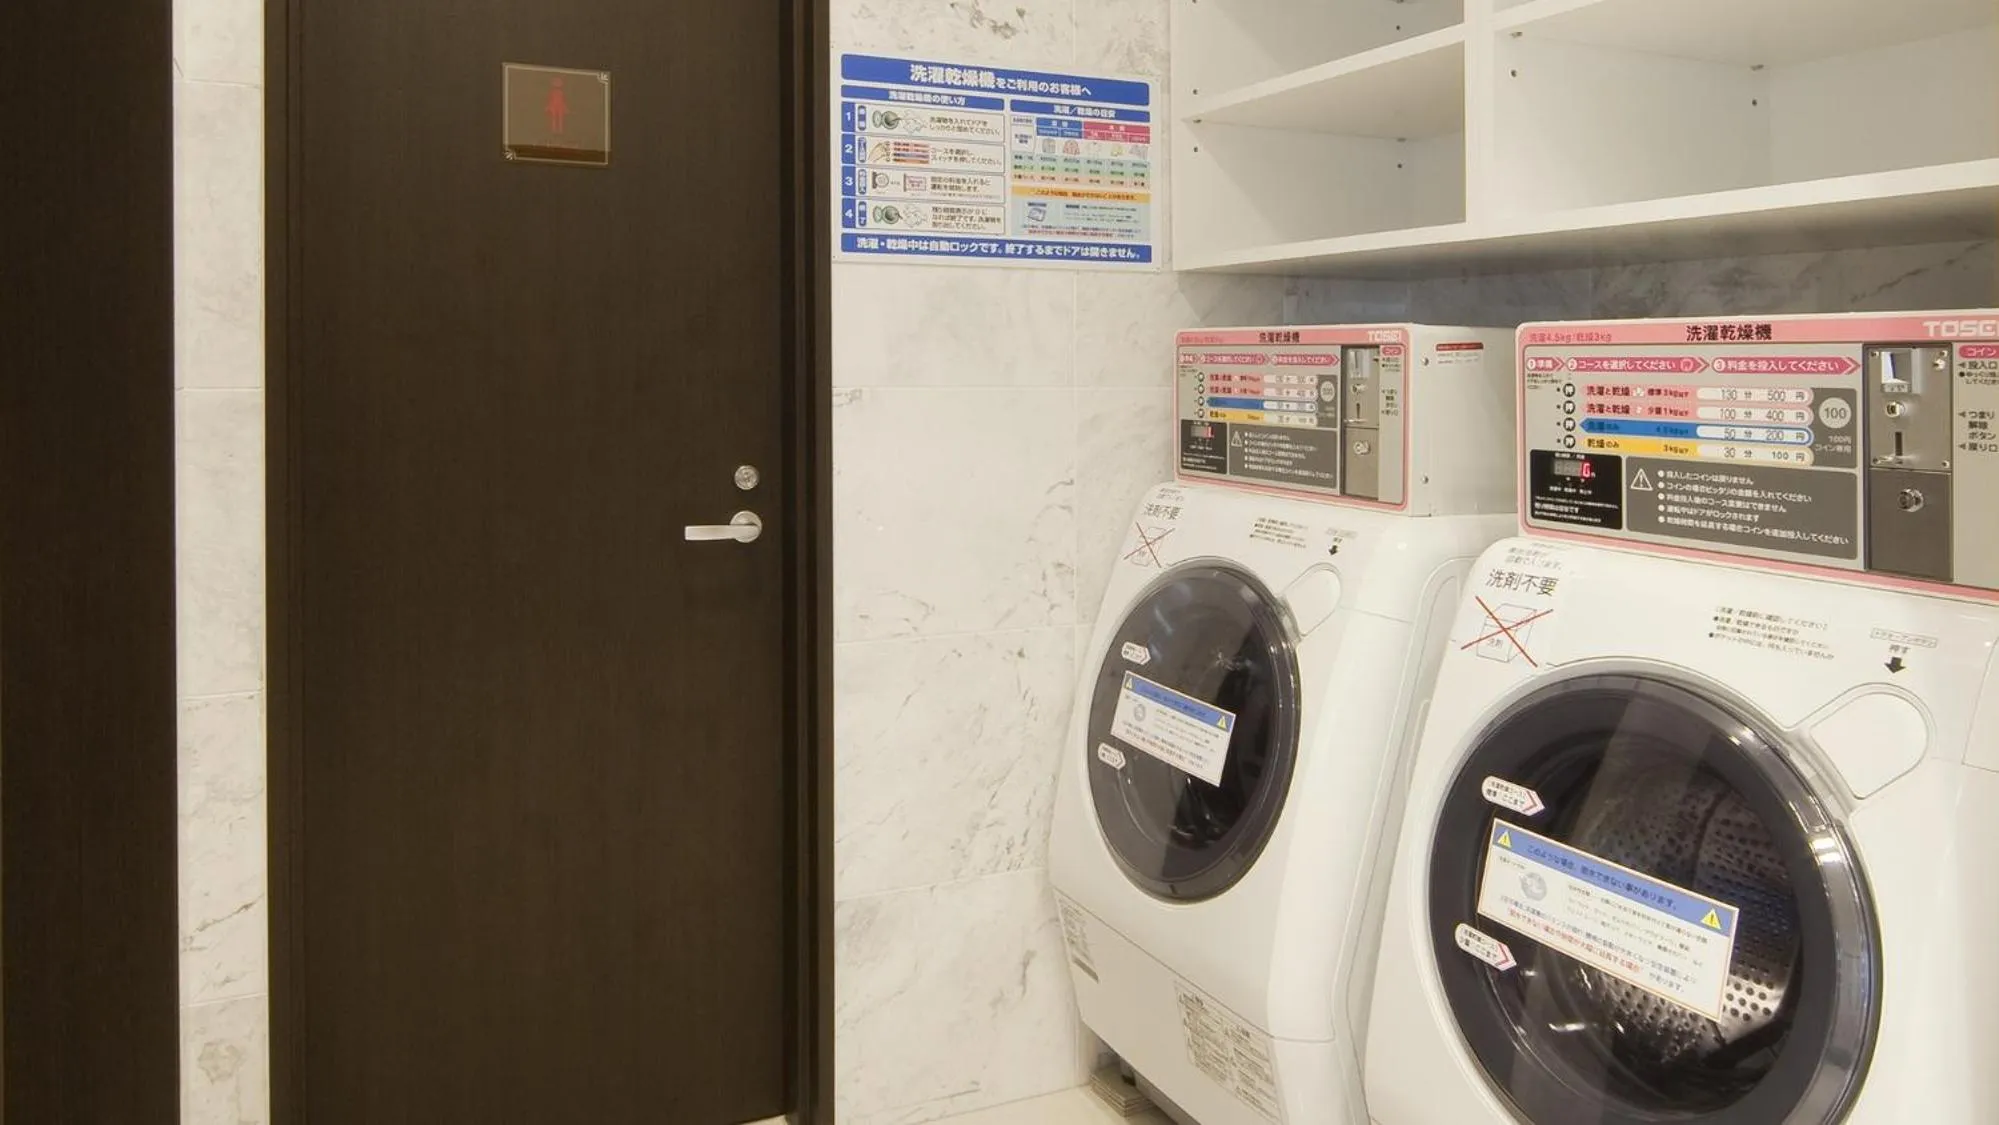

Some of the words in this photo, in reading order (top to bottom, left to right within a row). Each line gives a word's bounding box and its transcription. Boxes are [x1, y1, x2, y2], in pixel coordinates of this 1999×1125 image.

[910, 64, 1092, 97] 洗濯乾燥機をご利用のお客様へ
[846, 112, 851, 121] 1
[845, 144, 853, 153] 2
[845, 176, 853, 186] 3
[845, 209, 853, 218] 4
[1686, 324, 1772, 342] 洗濯乾燥機
[1968, 347, 1997, 357] コイン
[1578, 360, 1676, 371] コースを選択してください
[1727, 360, 1840, 371] 料金を投入してください
[1587, 385, 1630, 397] 洗濯と乾燥
[1767, 389, 1786, 402] 500
[1587, 404, 1630, 415] 洗濯と乾燥
[1720, 408, 1736, 420] 100
[1766, 410, 1785, 422] 400
[1824, 407, 1847, 419] 100
[1724, 428, 1736, 440] 50
[1766, 430, 1785, 442] 200
[1724, 447, 1736, 459] 30
[1772, 451, 1789, 460] 100
[1486, 568, 1560, 596] 洗剤不要
